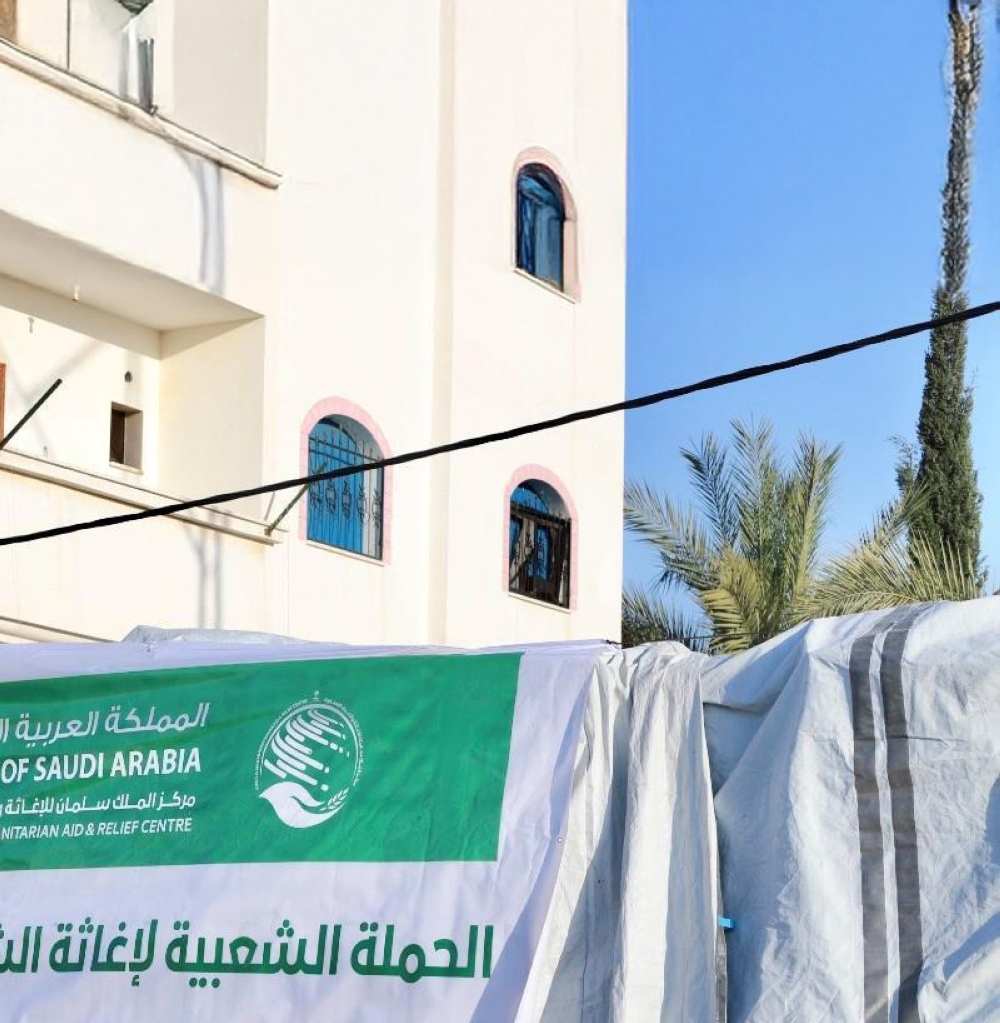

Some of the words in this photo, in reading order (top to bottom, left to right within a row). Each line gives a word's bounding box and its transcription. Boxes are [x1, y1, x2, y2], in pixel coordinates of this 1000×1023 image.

[14, 710, 100, 749] العربية
[104, 702, 212, 734] المملكة
[0, 758, 30, 784] OF
[33, 751, 104, 781] SAUDI
[109, 747, 202, 778] ARABIA
[4, 795, 55, 817] للإغاثة
[55, 796, 111, 814] سلمان
[112, 792, 157, 810] الملك
[156, 791, 196, 811] مركز
[61, 823, 85, 838] AID
[85, 822, 95, 836] &
[96, 820, 140, 835] RELIEF
[140, 817, 193, 834] CENTRE
[48, 916, 158, 987] لإغاثة
[165, 918, 342, 988] الشعبية
[350, 921, 494, 984] الحملة
